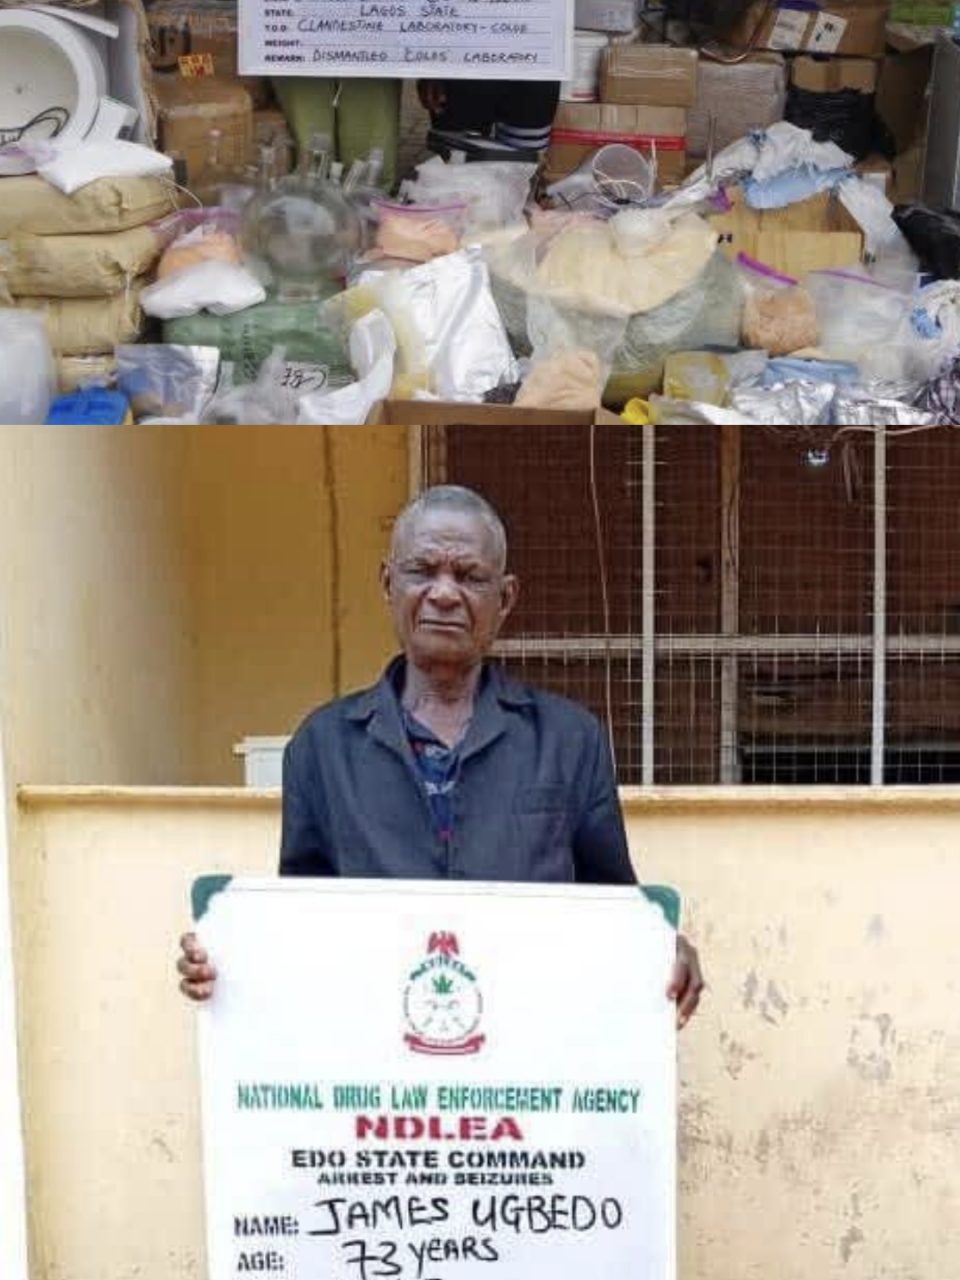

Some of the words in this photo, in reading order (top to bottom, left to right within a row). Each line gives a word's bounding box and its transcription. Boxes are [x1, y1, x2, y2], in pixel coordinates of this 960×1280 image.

[237, 1083, 323, 1110] NATIONAL
[333, 1084, 381, 1110] DRUG
[391, 1085, 428, 1110] LAW
[438, 1086, 563, 1112] ENFORCEMENT
[572, 1087, 640, 1113] AGENCY
[355, 1115, 524, 1141] NDLEA
[291, 1150, 345, 1169] EDO
[356, 1150, 439, 1169] STATE
[448, 1150, 586, 1169] COMMAND
[317, 1172, 398, 1185] ARREST
[405, 1172, 447, 1185] AND
[454, 1172, 554, 1185] SEIZURES
[234, 1216, 299, 1236] NAME:
[306, 1195, 450, 1236] JAMES
[472, 1194, 623, 1234] UGBEDO
[237, 1251, 284, 1272] AGE:
[341, 1239, 403, 1280] 73
